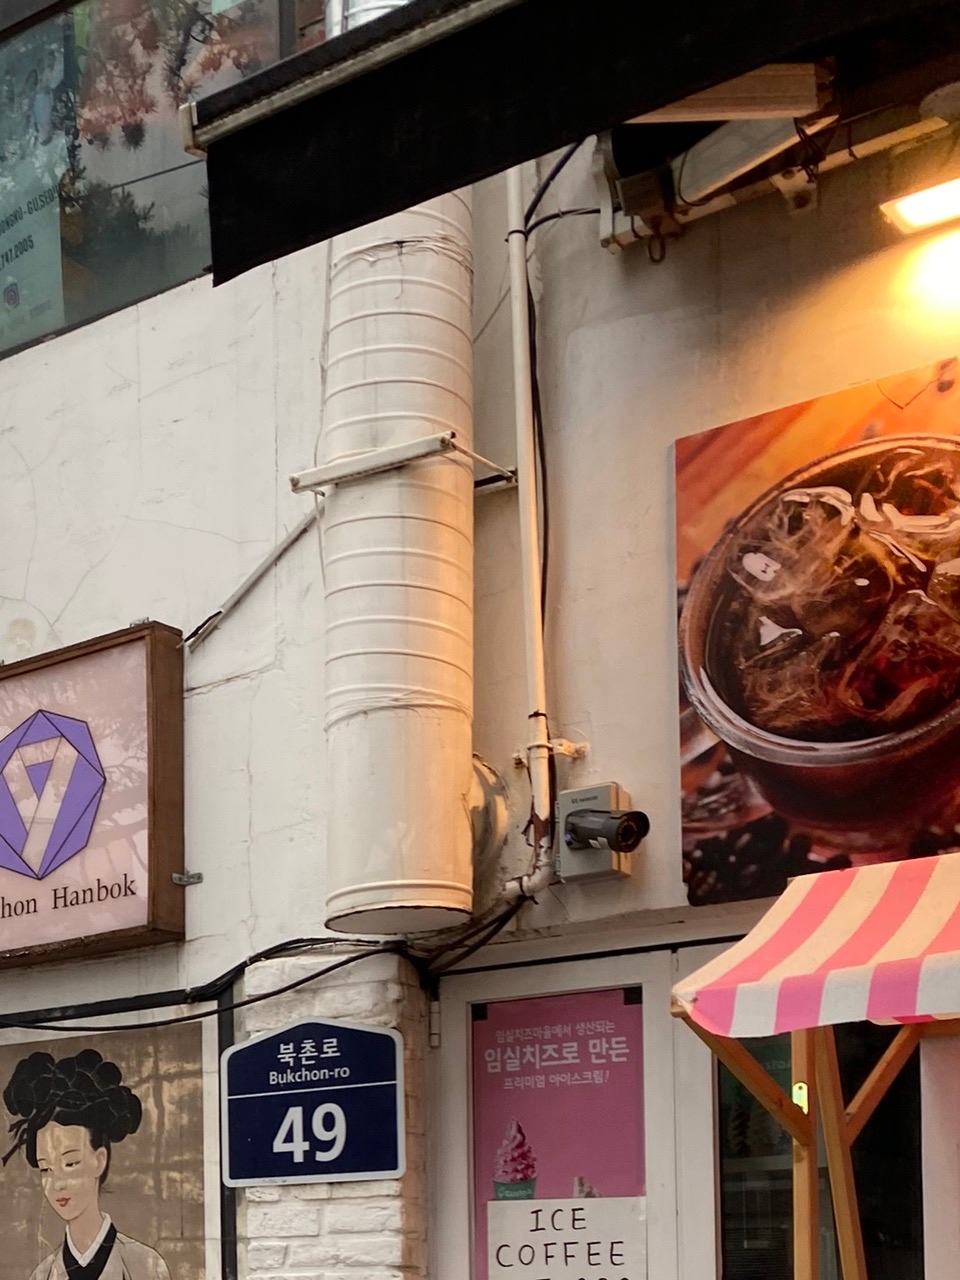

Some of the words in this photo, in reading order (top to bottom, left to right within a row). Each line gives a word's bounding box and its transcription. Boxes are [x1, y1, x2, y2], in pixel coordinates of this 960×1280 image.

[51, 872, 137, 910] Hanbok
[277, 1037, 341, 1067] 북촌로
[484, 1041, 581, 1073] 임실치즈로
[589, 1036, 630, 1064] 만든
[269, 1067, 350, 1085] Bukchon-ro
[503, 1074, 546, 1091] 프리미엄
[548, 1069, 611, 1088] 아이스크림!
[272, 1102, 347, 1163] 49
[529, 1207, 588, 1233] ICE
[495, 1240, 626, 1269] COFFEE
